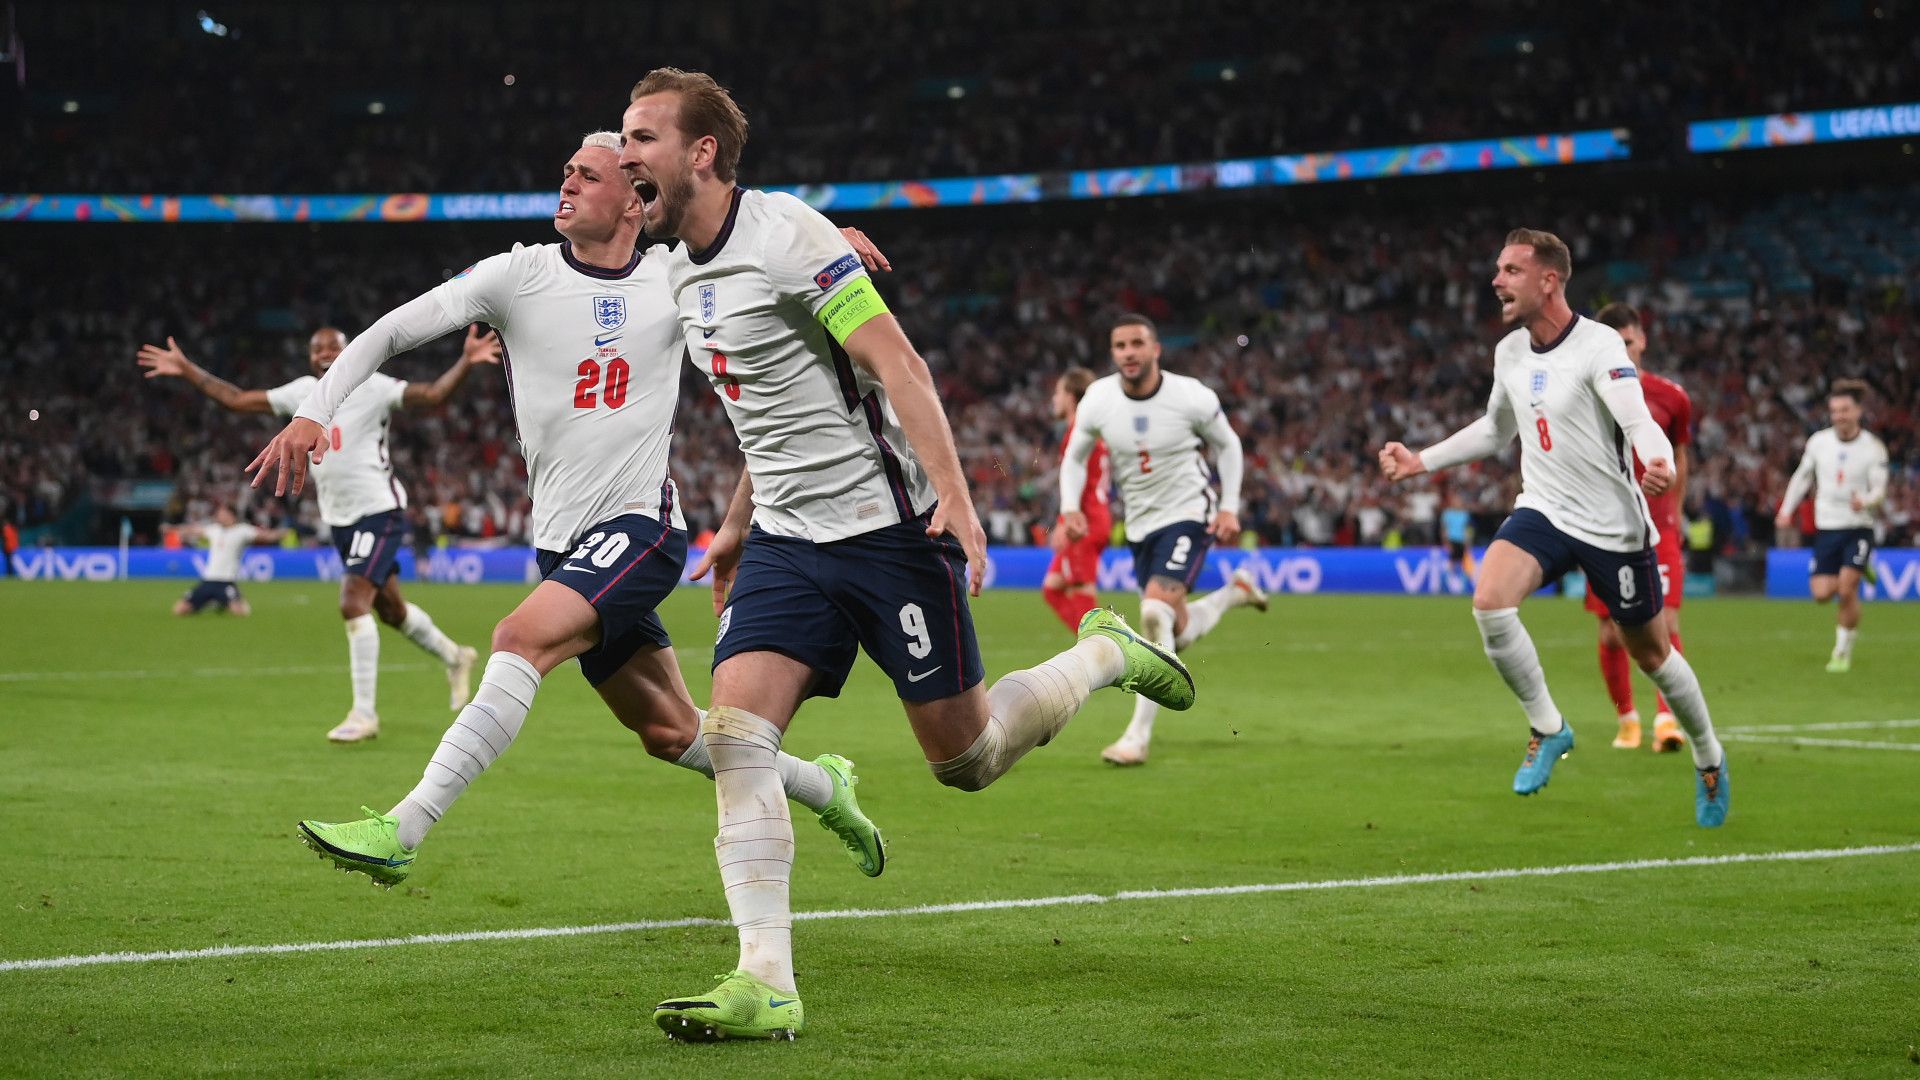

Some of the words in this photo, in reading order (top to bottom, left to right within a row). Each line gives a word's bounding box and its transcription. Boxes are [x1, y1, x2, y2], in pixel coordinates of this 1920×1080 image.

[1829, 109, 1890, 138] UEFA
[443, 194, 499, 218] UEFA
[845, 287, 865, 303] GAME
[840, 299, 869, 324] RESPECT
[574, 358, 629, 409] 20
[1536, 418, 1552, 452] 8
[1138, 449, 1152, 474] 2
[349, 530, 375, 558] 10
[568, 531, 630, 568] 20
[1170, 535, 1192, 566] 2
[11, 546, 117, 581] vivo
[1617, 564, 1637, 600] 8
[898, 602, 933, 660] 9
